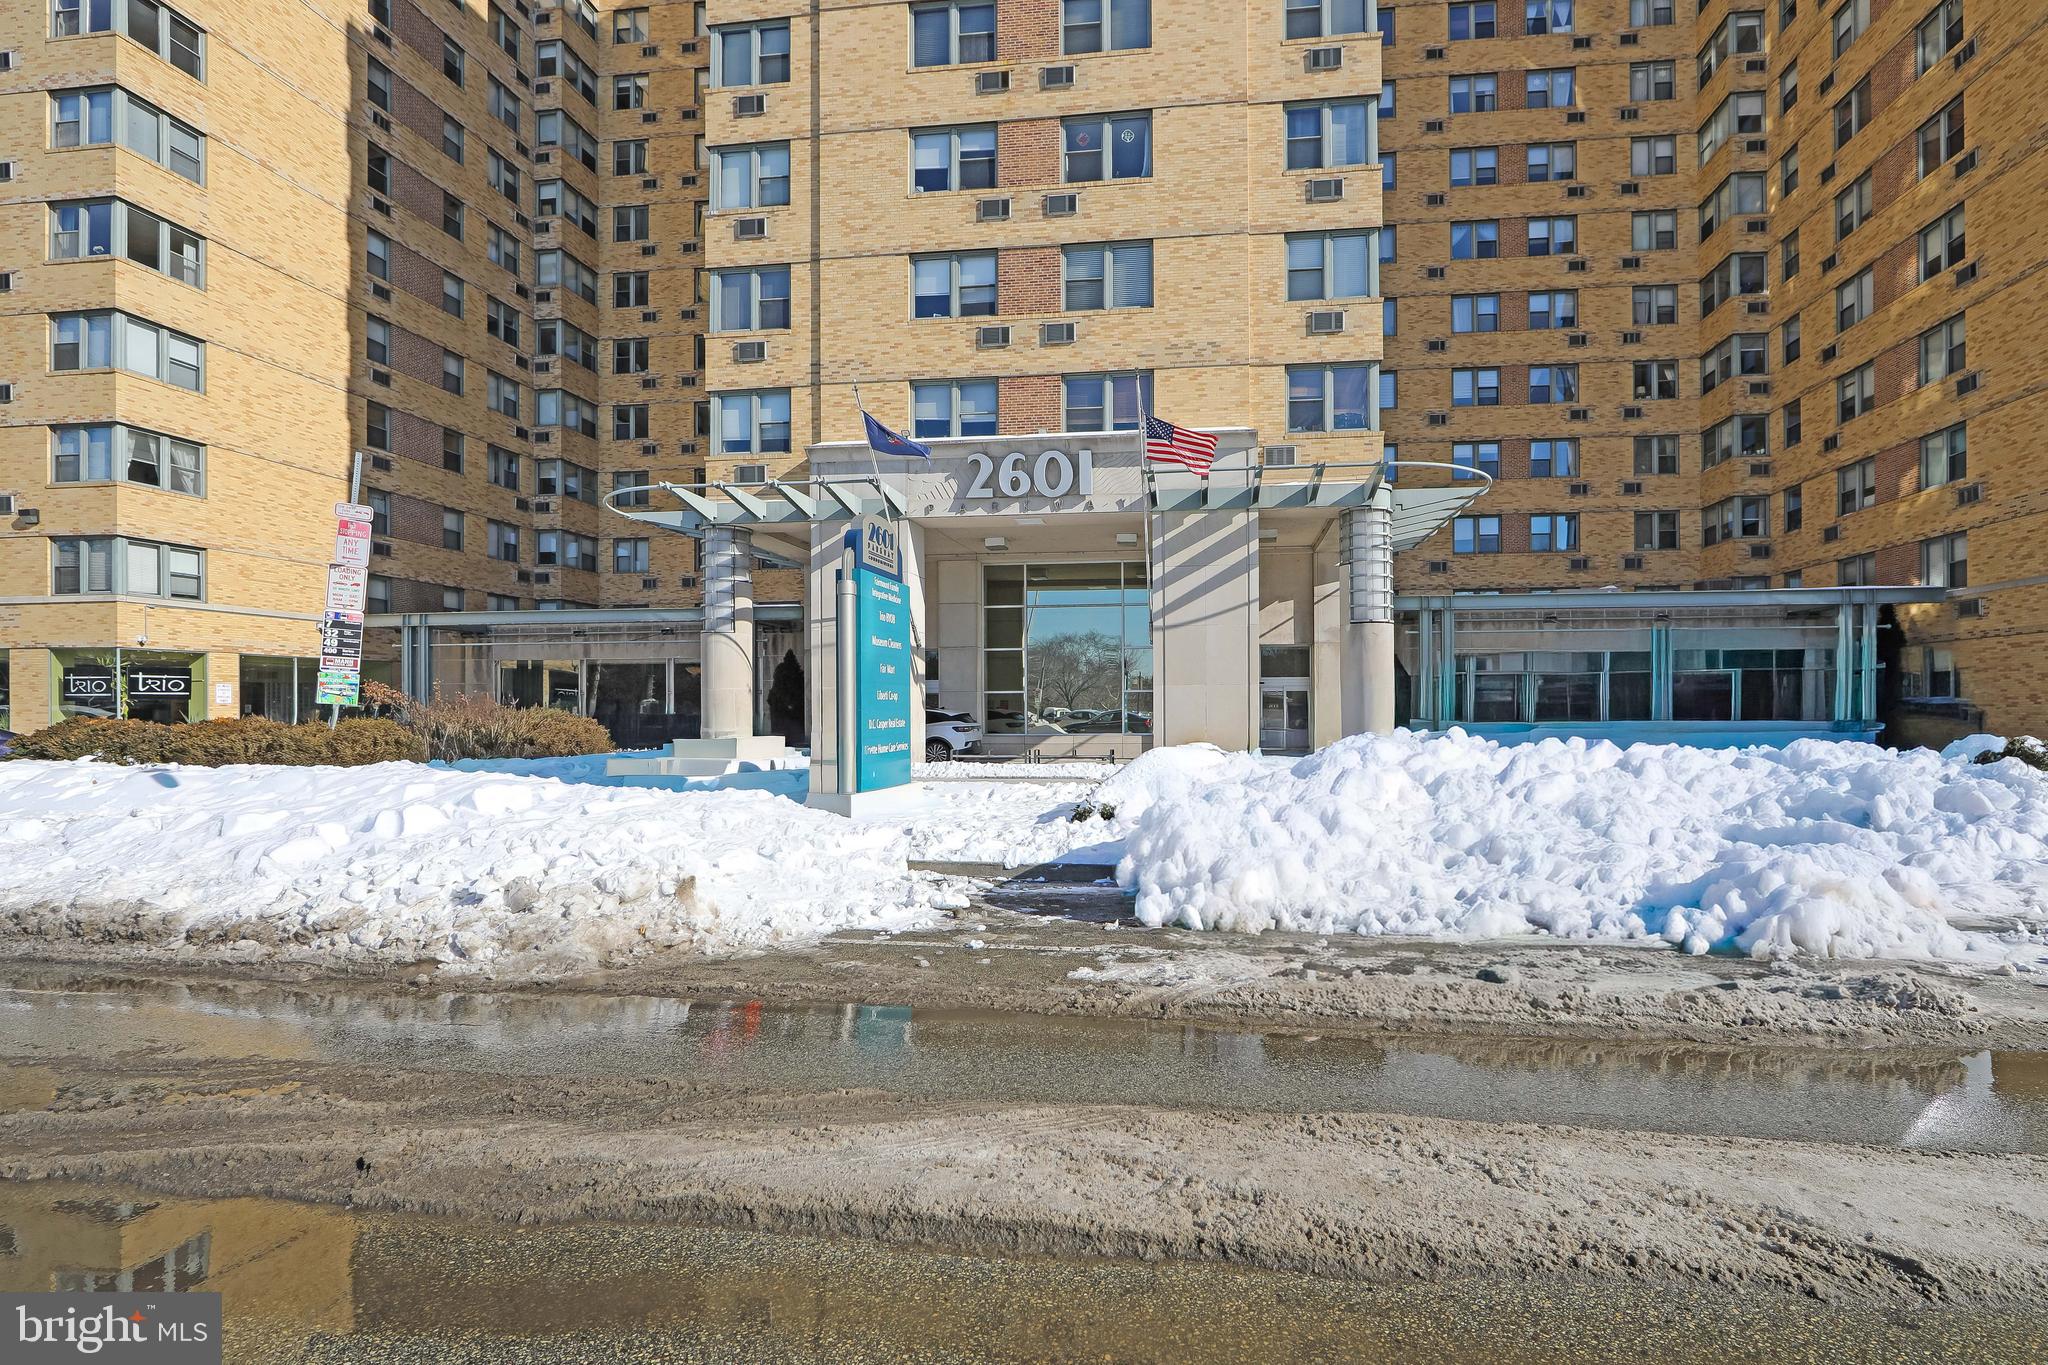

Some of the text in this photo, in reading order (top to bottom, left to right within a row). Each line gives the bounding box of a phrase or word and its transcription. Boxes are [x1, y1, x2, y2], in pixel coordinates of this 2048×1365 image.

[966, 449, 1093, 499] 2601
[340, 528, 367, 538] STOPPING
[868, 522, 894, 551] 2601
[344, 538, 359, 546] ANY
[342, 546, 360, 554] TIME
[868, 542, 894, 560] PARKWAY
[334, 568, 362, 576] LOADING
[325, 619, 333, 628] 7
[324, 629, 339, 638] 32
[323, 639, 338, 647] 49
[872, 636, 887, 646] Museum
